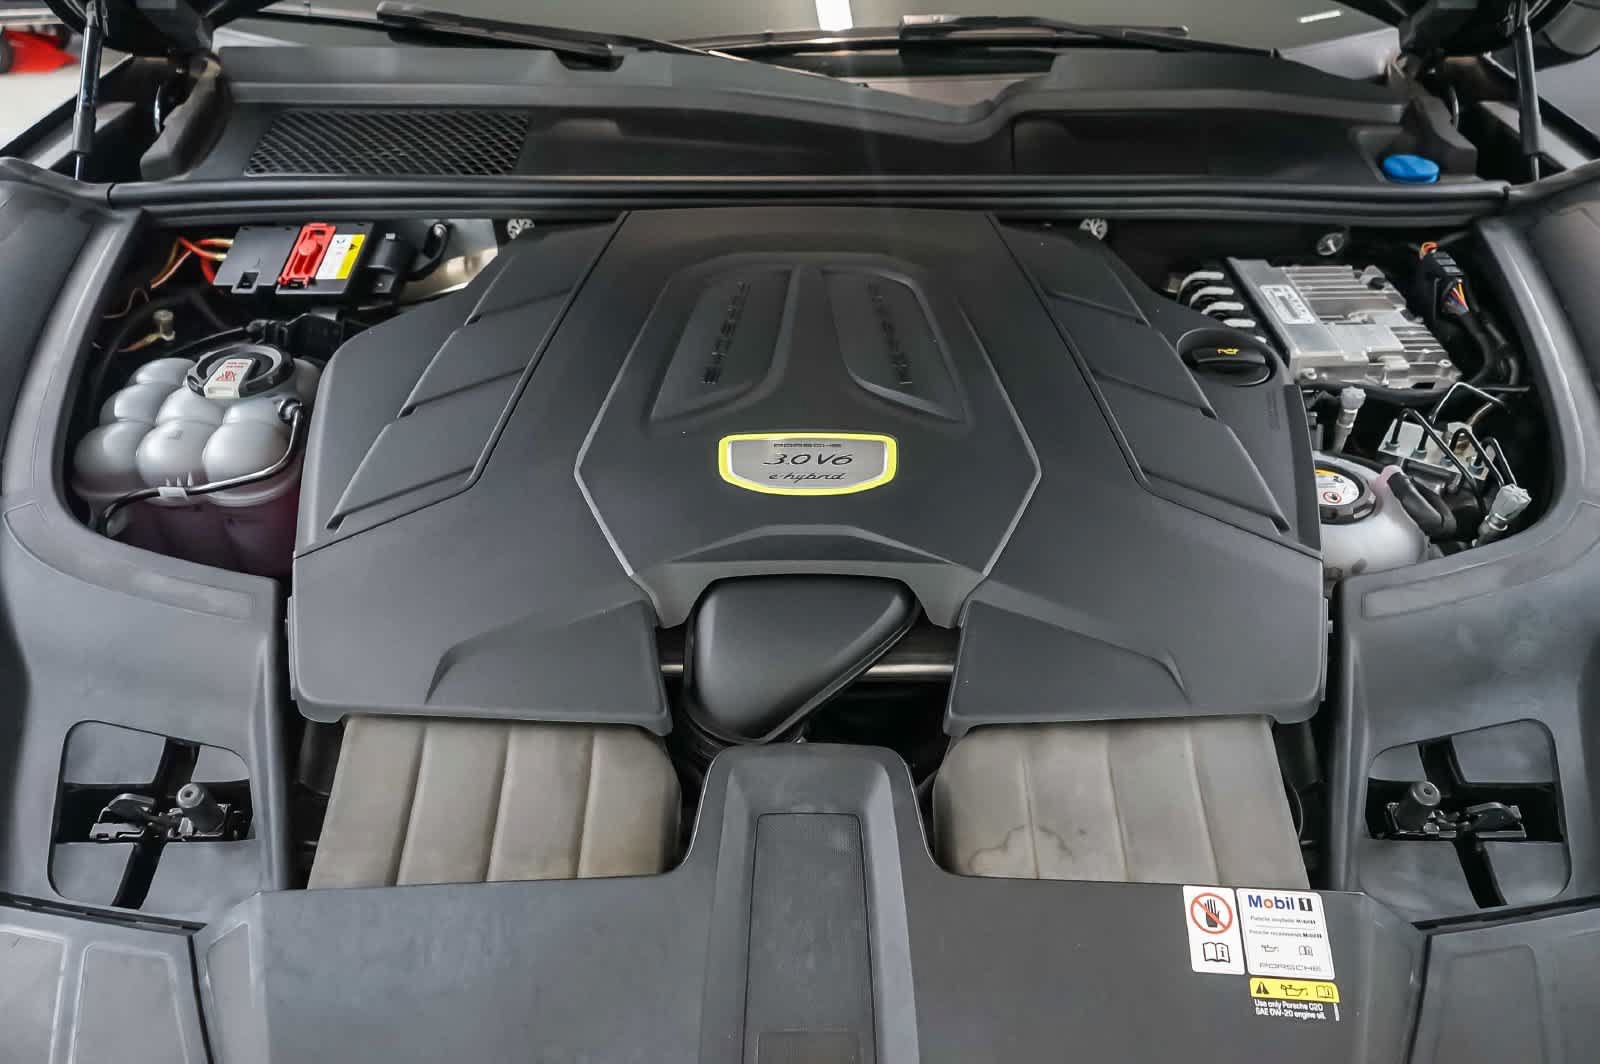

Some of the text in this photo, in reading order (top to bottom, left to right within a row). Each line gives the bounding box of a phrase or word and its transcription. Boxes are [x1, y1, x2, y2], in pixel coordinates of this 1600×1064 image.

[817, 453, 853, 466] V6
[1247, 894, 1313, 912] Mobil 1
[1254, 999, 1267, 1008] Use
[1268, 1000, 1281, 1009] only
[1282, 1001, 1308, 1010] Porsche
[1255, 1007, 1269, 1016] SAE
[1269, 1008, 1293, 1017] 0W-20
[1294, 1011, 1316, 1020] engine
